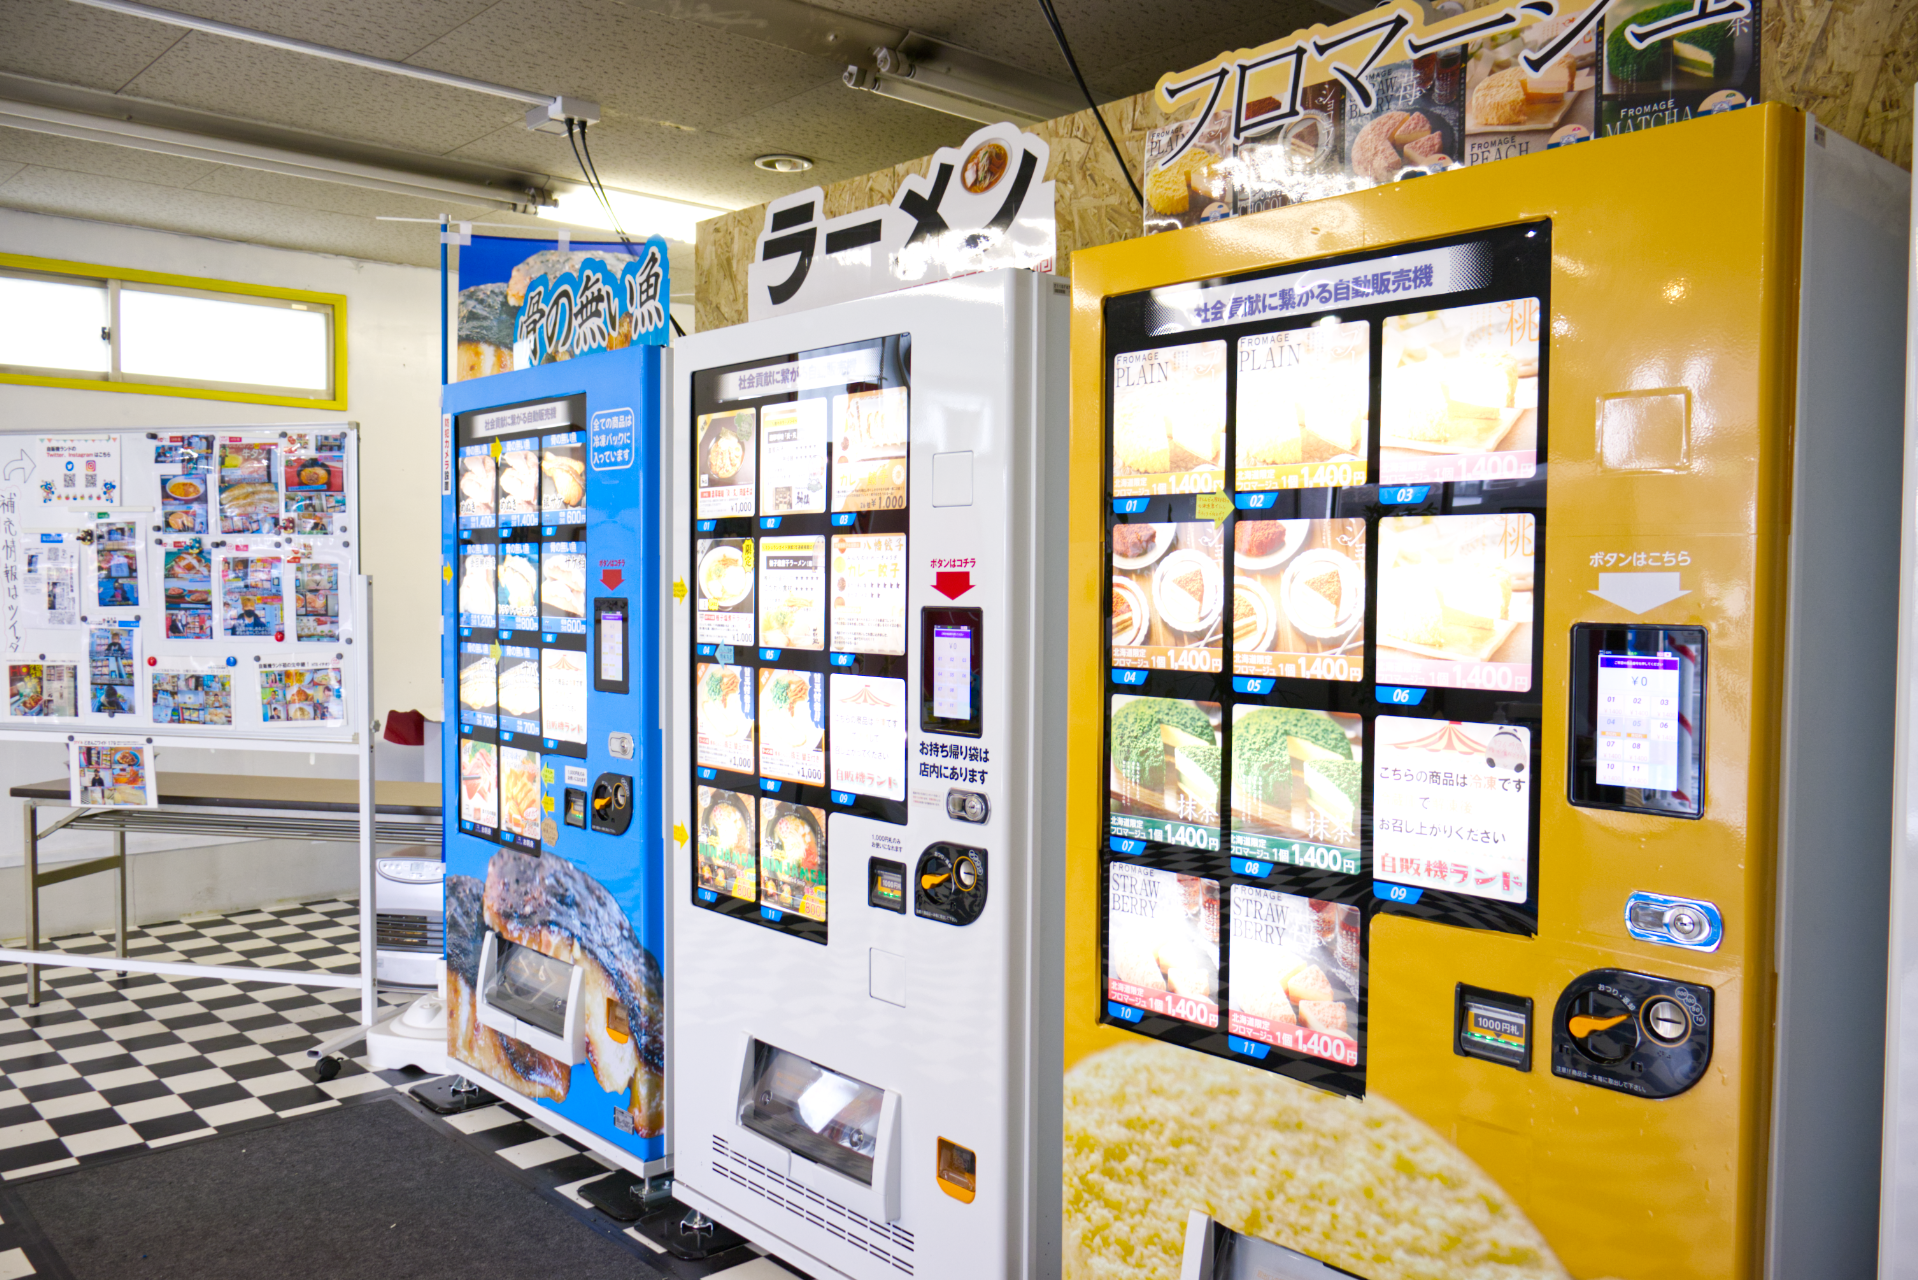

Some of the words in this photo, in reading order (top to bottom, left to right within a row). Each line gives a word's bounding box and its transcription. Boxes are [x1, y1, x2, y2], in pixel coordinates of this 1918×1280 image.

[1365, 68, 1392, 80] MAGE
[1620, 99, 1675, 119] FROMAGE
[1605, 106, 1693, 138] MATCHA
[1151, 126, 1183, 139] FROMAGE
[1470, 136, 1516, 152] FROMAGE
[1469, 141, 1530, 166] PEACH
[1239, 196, 1293, 216] CHOCOL
[762, 148, 1038, 305] ラーメン
[1194, 263, 1434, 324] 社会貢献に繋がる自動販売機
[1240, 333, 1290, 348] FROMAGE
[1116, 350, 1159, 365] FROMAGE
[1239, 343, 1300, 372] PLAIN
[1115, 361, 1169, 388] PLAIN
[593, 414, 632, 431] 全ての商品は
[593, 432, 630, 448] 冷凍パックに
[242, 448, 267, 459] 牛タン
[593, 448, 630, 464] 入っています
[1236, 469, 1275, 481] 北海道限定
[1236, 479, 1278, 492] フロマージュ
[1281, 474, 1299, 488] 1個
[1300, 464, 1366, 489] 1,400円
[1434, 464, 1454, 480] 1個
[1114, 476, 1147, 488] 北海道限定
[1114, 486, 1150, 498] フロマージュ
[1152, 481, 1167, 495] 1個
[1249, 494, 1264, 508] 02
[1397, 488, 1413, 502] 03
[731, 501, 752, 514] ¥1,000
[1126, 499, 1138, 512] 01
[766, 518, 774, 527] 02
[839, 515, 848, 524] 03
[1500, 515, 1534, 559] 桃
[930, 557, 977, 569] ボタンはコチラ
[1589, 551, 1691, 567] ボタンはこちら
[847, 562, 900, 578] カレー餃子
[702, 646, 710, 655] 04
[765, 650, 774, 659] 05
[1113, 648, 1146, 658] 北海道限定
[1234, 652, 1273, 665] 北海道限定
[838, 655, 847, 664] 06
[1113, 657, 1149, 668] フロマージュ
[1151, 655, 1166, 668] 1個
[1167, 649, 1222, 671] 1,400円
[1123, 671, 1136, 683] 04
[1233, 663, 1276, 675] フロマージュ
[1278, 662, 1296, 677] 1個
[1297, 657, 1362, 682] 1,400円
[1247, 679, 1261, 692] 05
[1429, 672, 1449, 686] 1個
[1453, 665, 1528, 691] 1,400円
[1631, 676, 1648, 687] ¥0
[1392, 688, 1409, 703] 06
[918, 740, 989, 763] お持ち帰り袋は
[729, 755, 751, 769] ¥1,000
[703, 769, 711, 778] 07
[797, 766, 822, 780] ¥1,000
[836, 767, 898, 790] 自販機ランド
[919, 761, 988, 785] 店内にあります
[1379, 766, 1526, 793] こちらの商品は冷凍です
[766, 780, 775, 790] 08
[839, 793, 848, 803] 09
[1177, 793, 1219, 823] 抹茶
[1111, 816, 1143, 829] 北海道限定
[1306, 811, 1355, 844] 抹茶
[1379, 817, 1506, 844] お召し上がりください
[1111, 827, 1146, 840] フロマージュ
[1148, 828, 1163, 842] 1個
[1164, 823, 1219, 851] 1,400円
[1121, 840, 1134, 852] 07
[699, 842, 755, 869] NINJAMEN
[1272, 848, 1289, 863] 1個
[1291, 843, 1355, 875] 1,400円
[762, 855, 826, 886] NINJAMEN
[1112, 862, 1155, 877] FROMAGE
[1245, 862, 1259, 875] 08
[1380, 852, 1525, 892] 自販機ランド
[1112, 872, 1160, 899] STRAW
[1233, 885, 1283, 902] FROMAGE
[1390, 886, 1406, 900] 09
[704, 891, 711, 900] 10
[768, 909, 775, 918] 11
[1111, 896, 1157, 919] BERRY
[1233, 897, 1289, 926] STRAW
[1233, 918, 1287, 947] BERRY
[1111, 980, 1144, 997] 北海道限定
[1111, 991, 1147, 1008] フロマージュ
[1148, 996, 1163, 1011] 1個
[1165, 995, 1219, 1027] 1,400円
[1120, 1006, 1132, 1019] 10
[1232, 1012, 1270, 1032] 北海道限定
[1477, 1016, 1520, 1036] 1000円札
[1232, 1023, 1273, 1041] フロマージュ
[1275, 1029, 1293, 1047] 1個
[1296, 1029, 1358, 1065] 1,400円
[1243, 1041, 1255, 1055] 11
